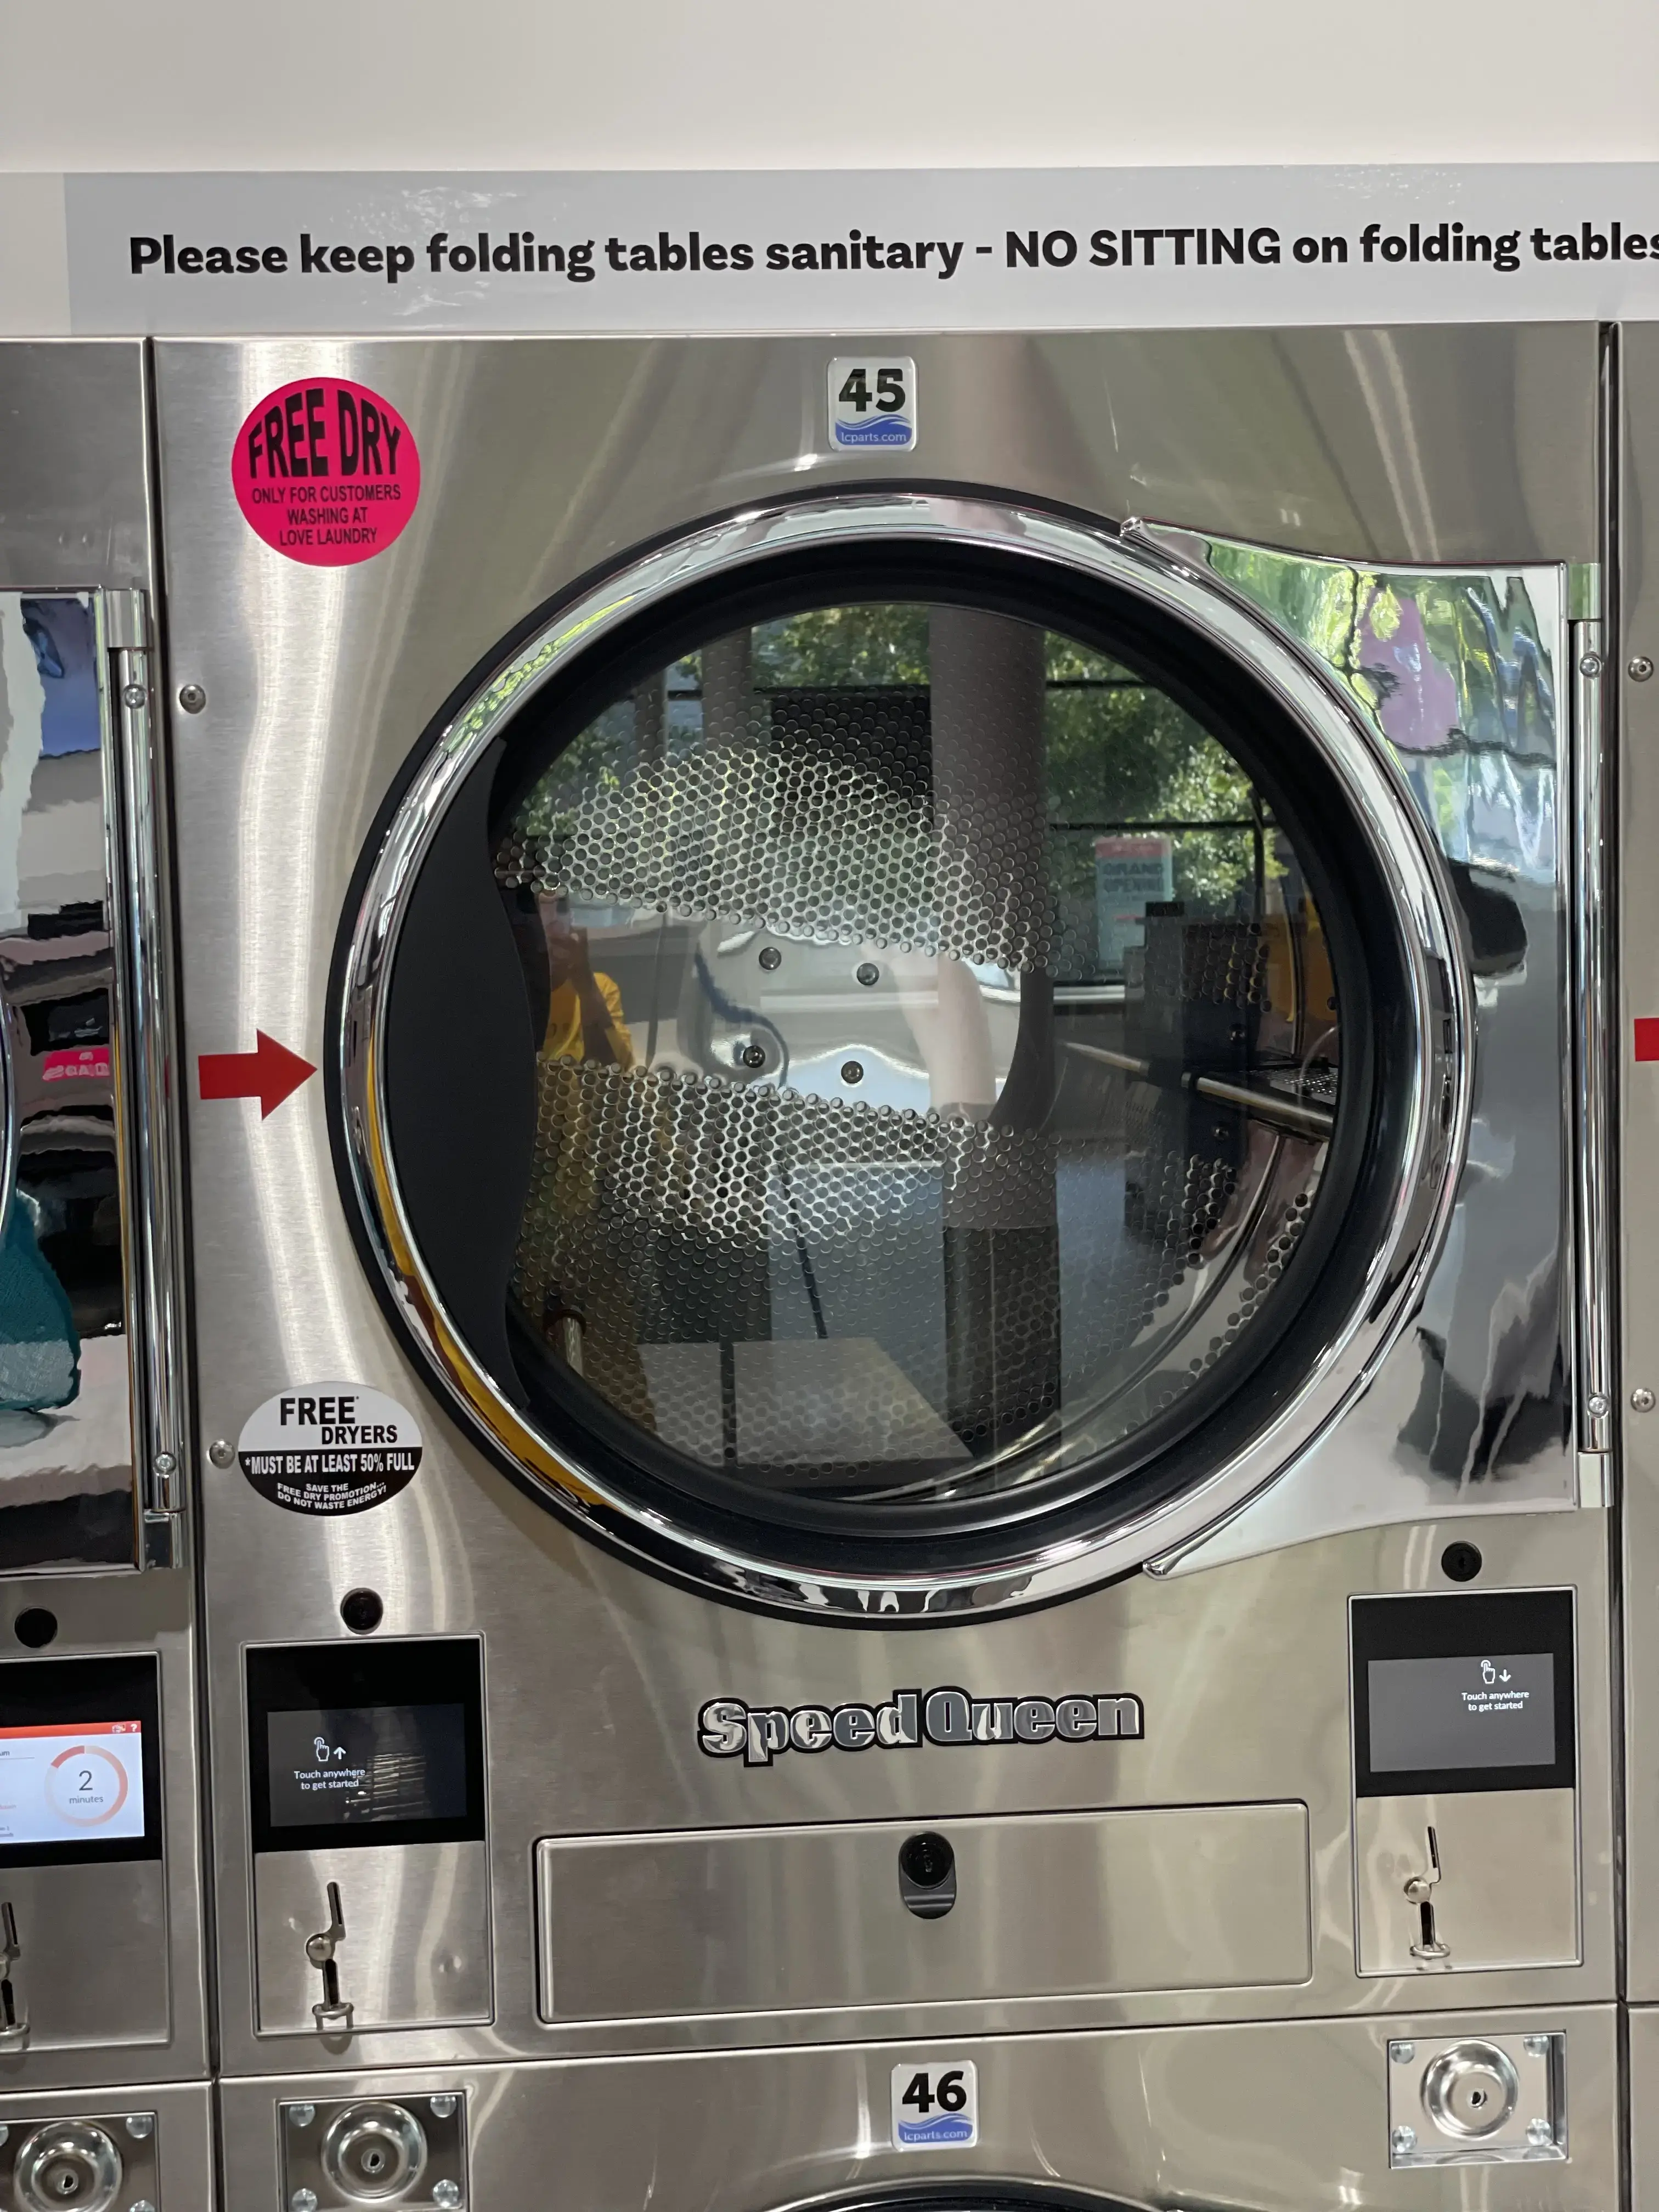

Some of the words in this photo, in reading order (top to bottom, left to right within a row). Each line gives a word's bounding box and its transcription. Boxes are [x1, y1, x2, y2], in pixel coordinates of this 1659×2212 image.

[130, 234, 288, 274] Please
[300, 233, 415, 284] keep
[426, 232, 595, 283] folding
[605, 232, 754, 271] tables
[766, 229, 964, 279] sanitary
[1006, 230, 1077, 268] NO
[1089, 227, 1280, 267] SITTING
[1293, 236, 1347, 263] on
[1359, 222, 1521, 272] folding
[839, 369, 906, 412] 45
[248, 388, 329, 479] FREE
[337, 389, 401, 476] DRY
[841, 432, 907, 443] lcparts.com
[252, 488, 286, 504] ONLY
[290, 486, 317, 503] FOR
[320, 484, 401, 502] CUSTOMERS
[287, 507, 349, 525] WASHING
[353, 506, 368, 523] AT
[280, 529, 313, 546] LOVE
[317, 527, 377, 545] LAUNDRY
[321, 1425, 398, 1444] DRYERS
[286, 1455, 302, 1474] BE
[304, 1455, 319, 1473] AT
[321, 1454, 358, 1472] LEAST
[360, 1453, 384, 1472] 50%
[386, 1452, 415, 1471] FULL
[277, 1482, 301, 1497] FREE
[303, 1491, 321, 1500] DRY
[306, 1483, 329, 1492] SAVE
[331, 1483, 349, 1492] THE
[277, 1491, 291, 1503] DO
[293, 1497, 312, 1508] NOT
[314, 1500, 345, 1510] WASTE
[347, 1485, 387, 1507] ENERGY!
[1461, 1691, 1487, 1701] Touch
[1488, 1690, 1530, 1701] anywhere
[1479, 1702, 1493, 1712] get
[1494, 1701, 1523, 1709] started
[78, 1770, 93, 1791] 2
[294, 1769, 321, 1779] Touch
[323, 1768, 366, 1779] anywhere
[312, 1781, 327, 1791] get
[328, 1779, 359, 1788] started
[69, 1795, 104, 1804] minutes
[902, 2070, 967, 2113] 46
